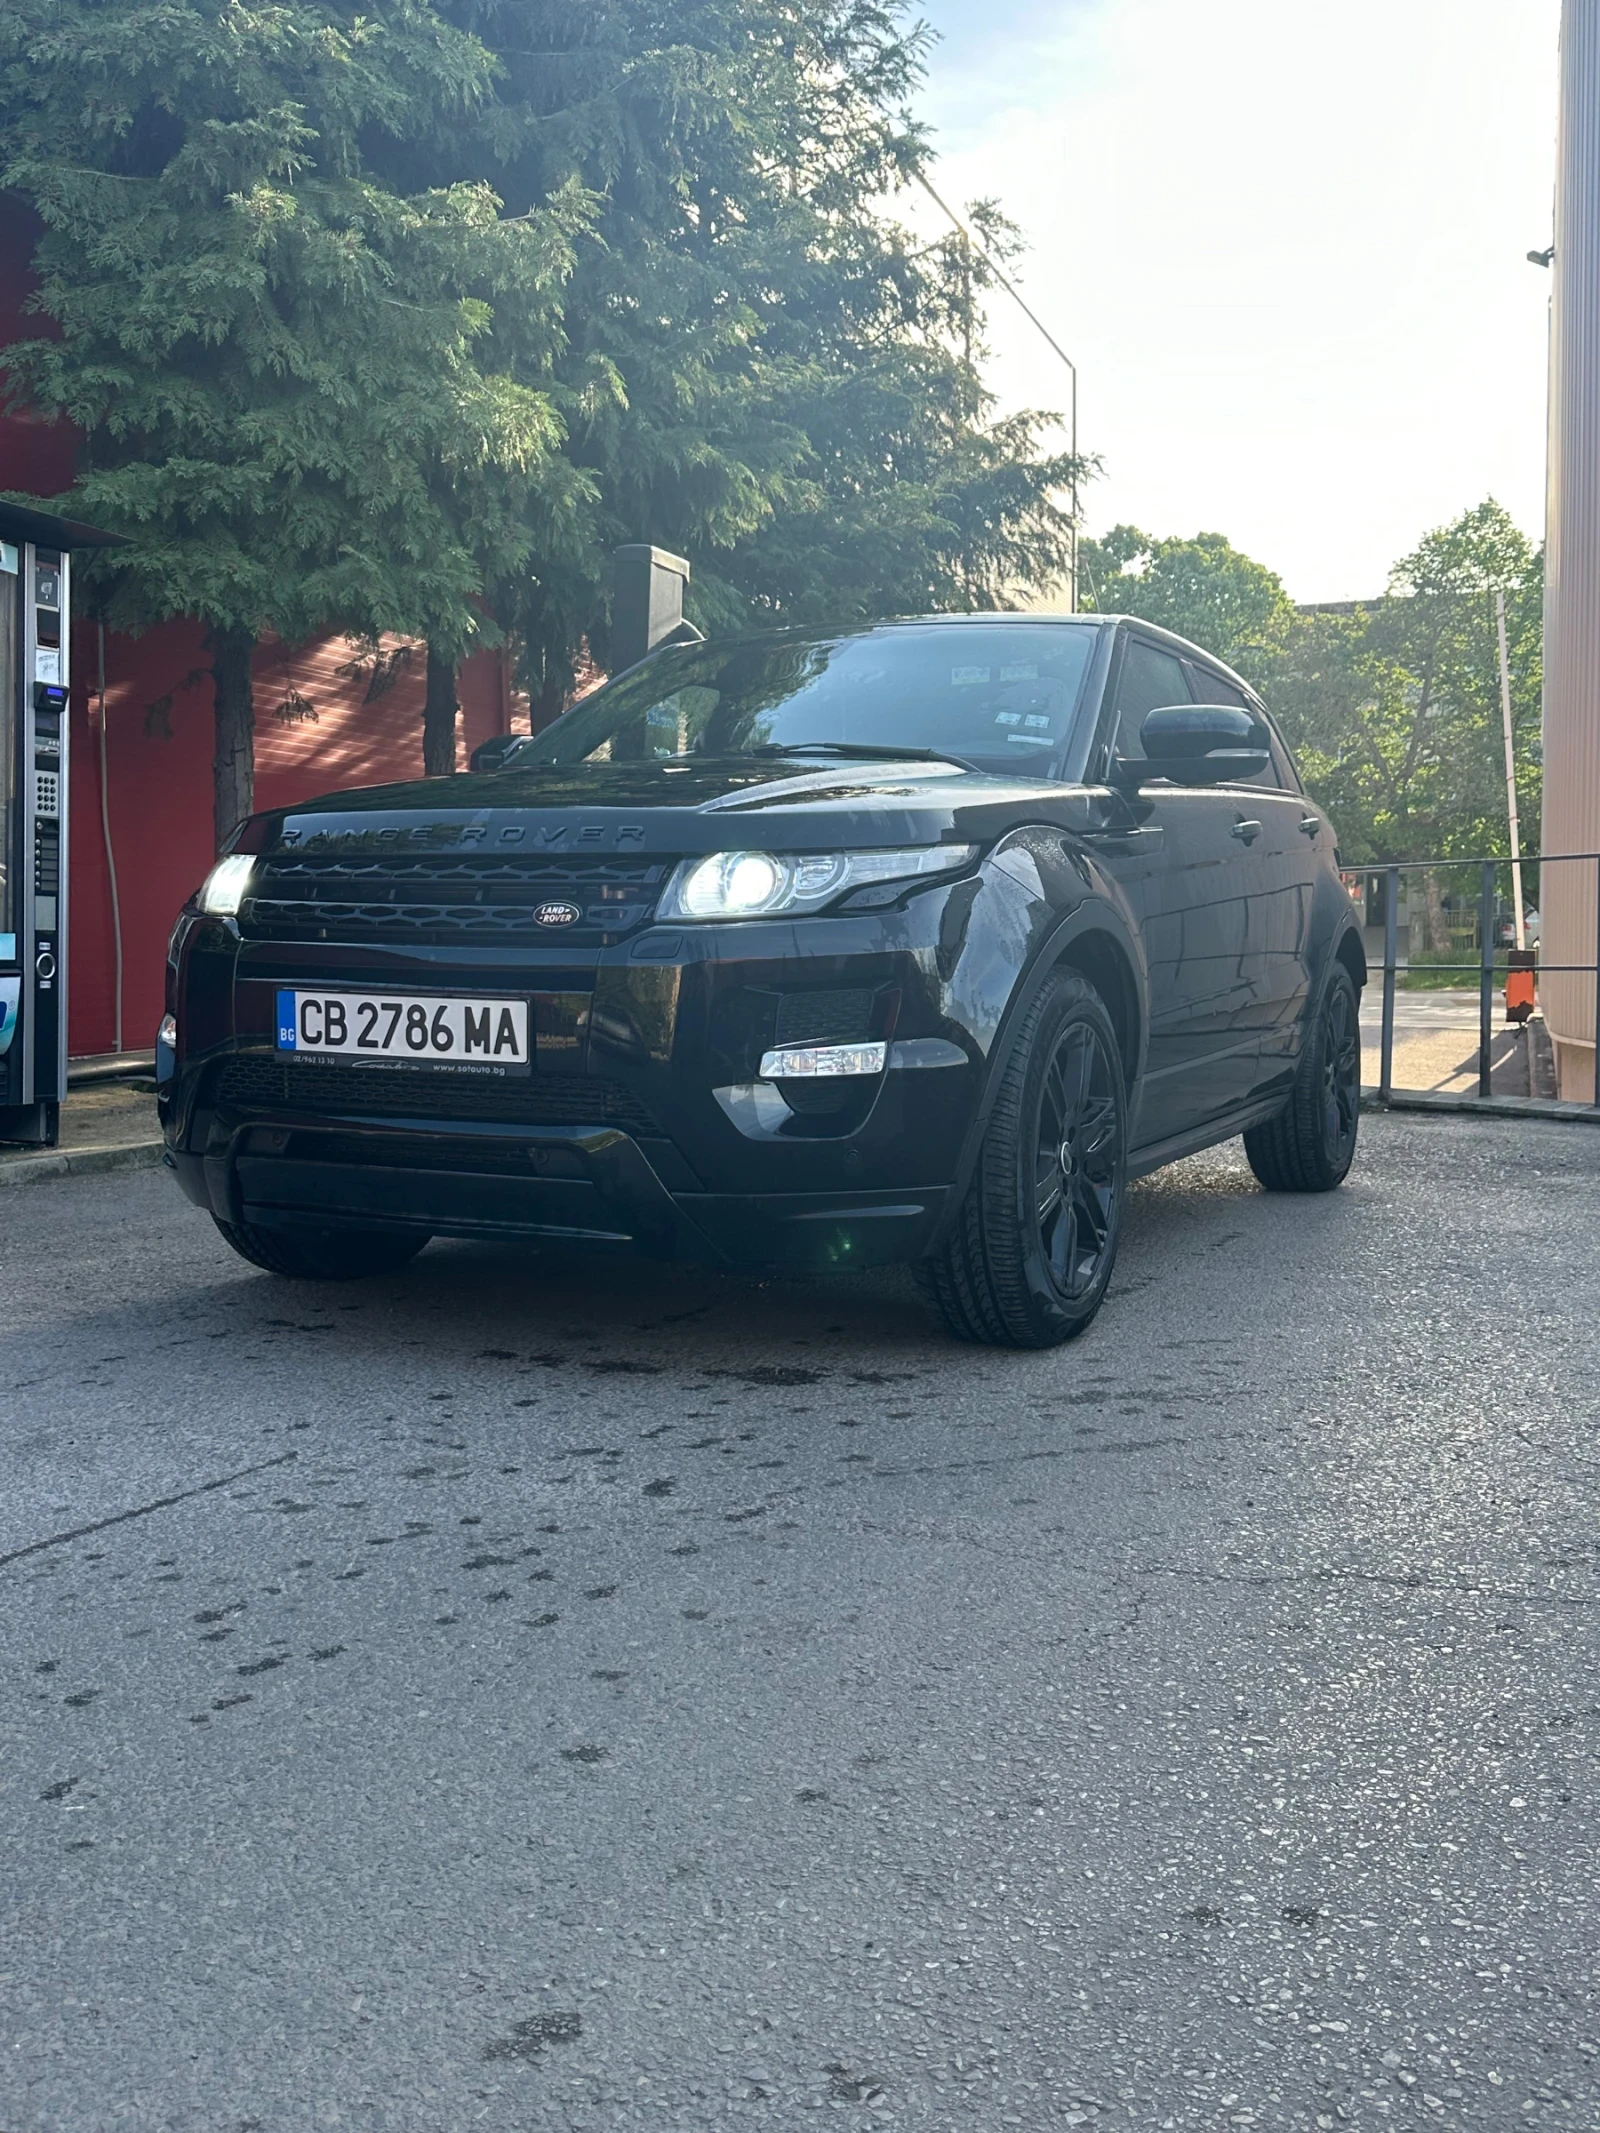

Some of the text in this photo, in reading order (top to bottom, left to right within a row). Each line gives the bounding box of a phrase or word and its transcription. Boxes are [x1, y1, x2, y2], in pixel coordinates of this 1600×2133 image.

[280, 826, 645, 844] RANGE ROVER
[280, 1027, 295, 1042] BG
[300, 999, 520, 1056] CB 2786 MA
